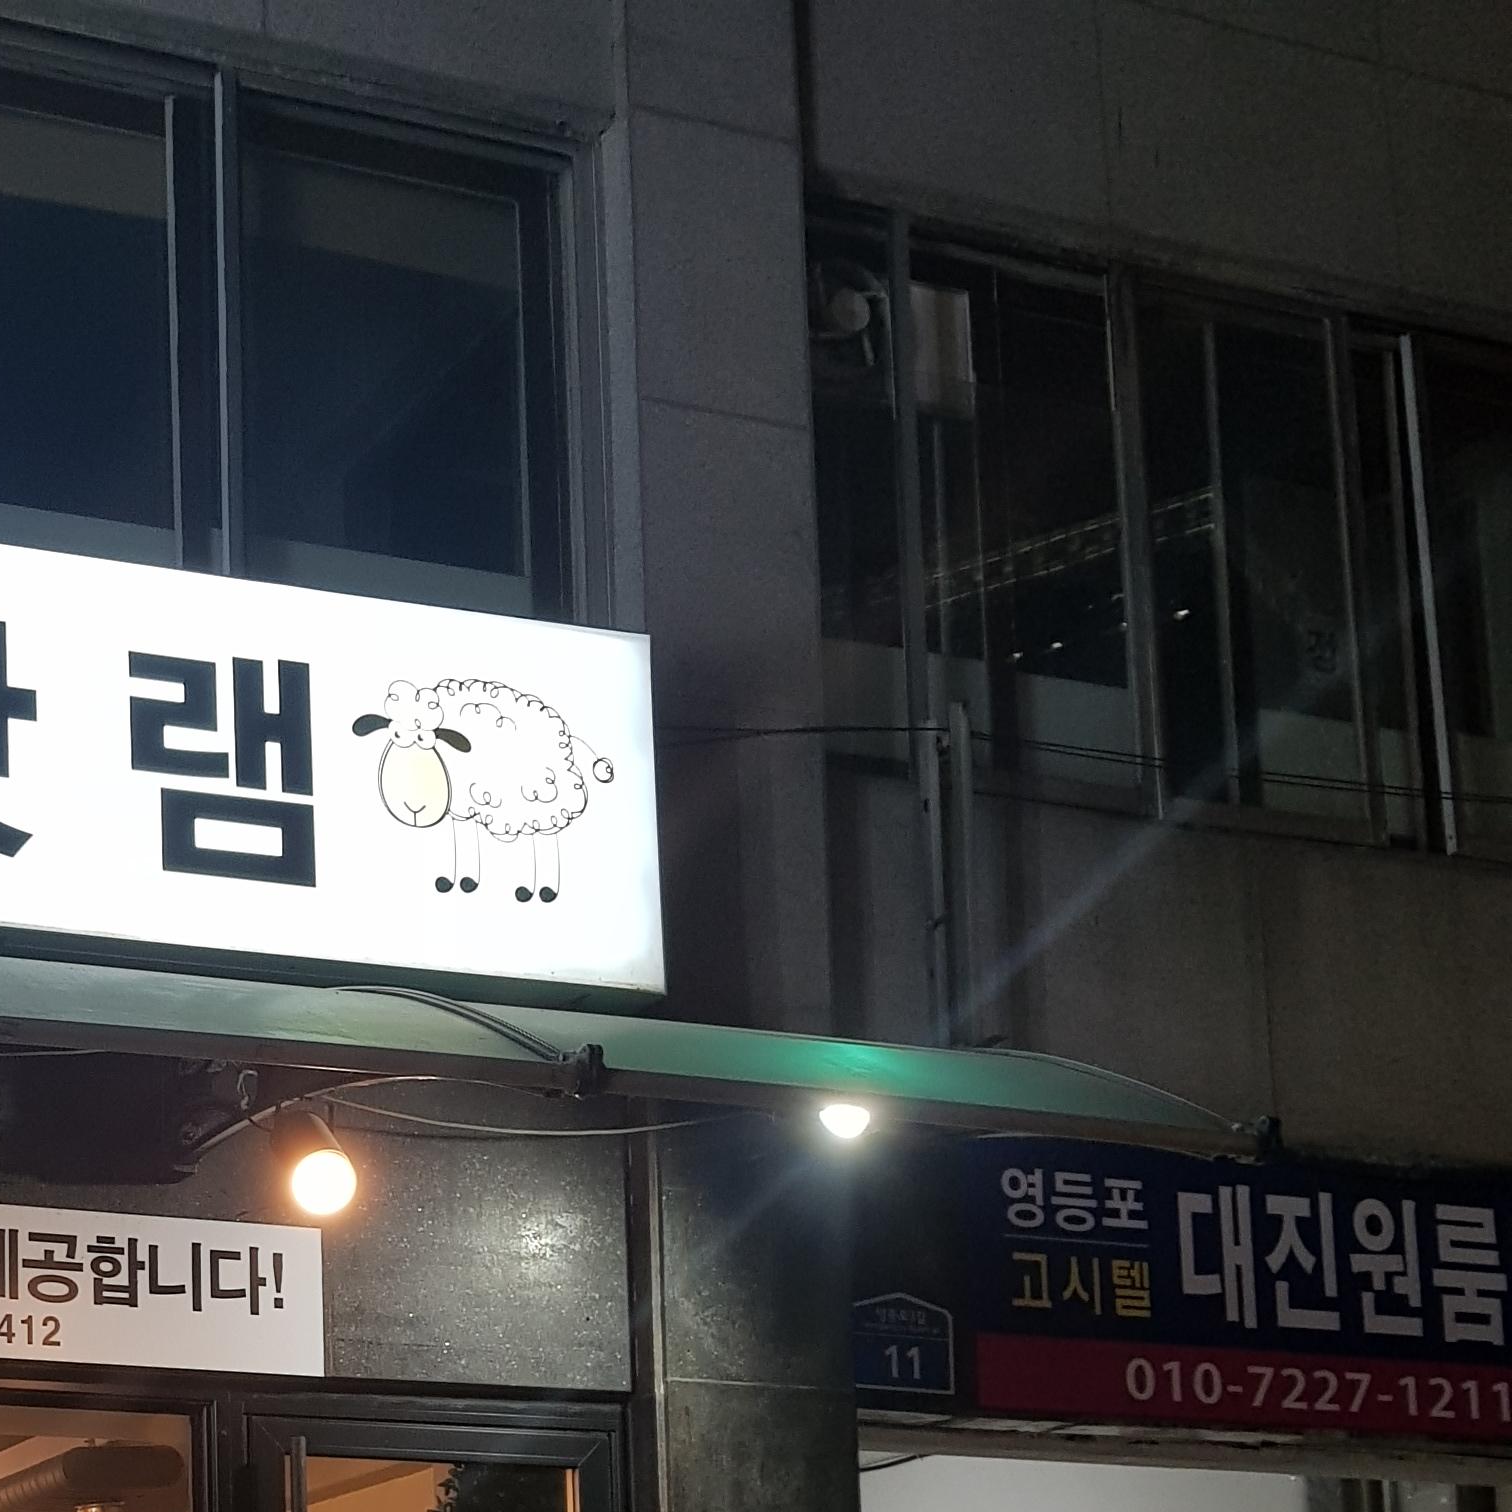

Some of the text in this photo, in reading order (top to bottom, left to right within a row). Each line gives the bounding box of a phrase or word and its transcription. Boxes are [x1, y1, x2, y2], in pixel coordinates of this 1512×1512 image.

[129, 650, 316, 888] 램
[1001, 1166, 1149, 1233] 영등포
[1011, 1251, 1151, 1318] 고시텔
[1177, 1184, 1508, 1346] 대진원룸
[884, 1344, 921, 1380] 11
[1125, 1357, 1512, 1421] 010-7227-1211
